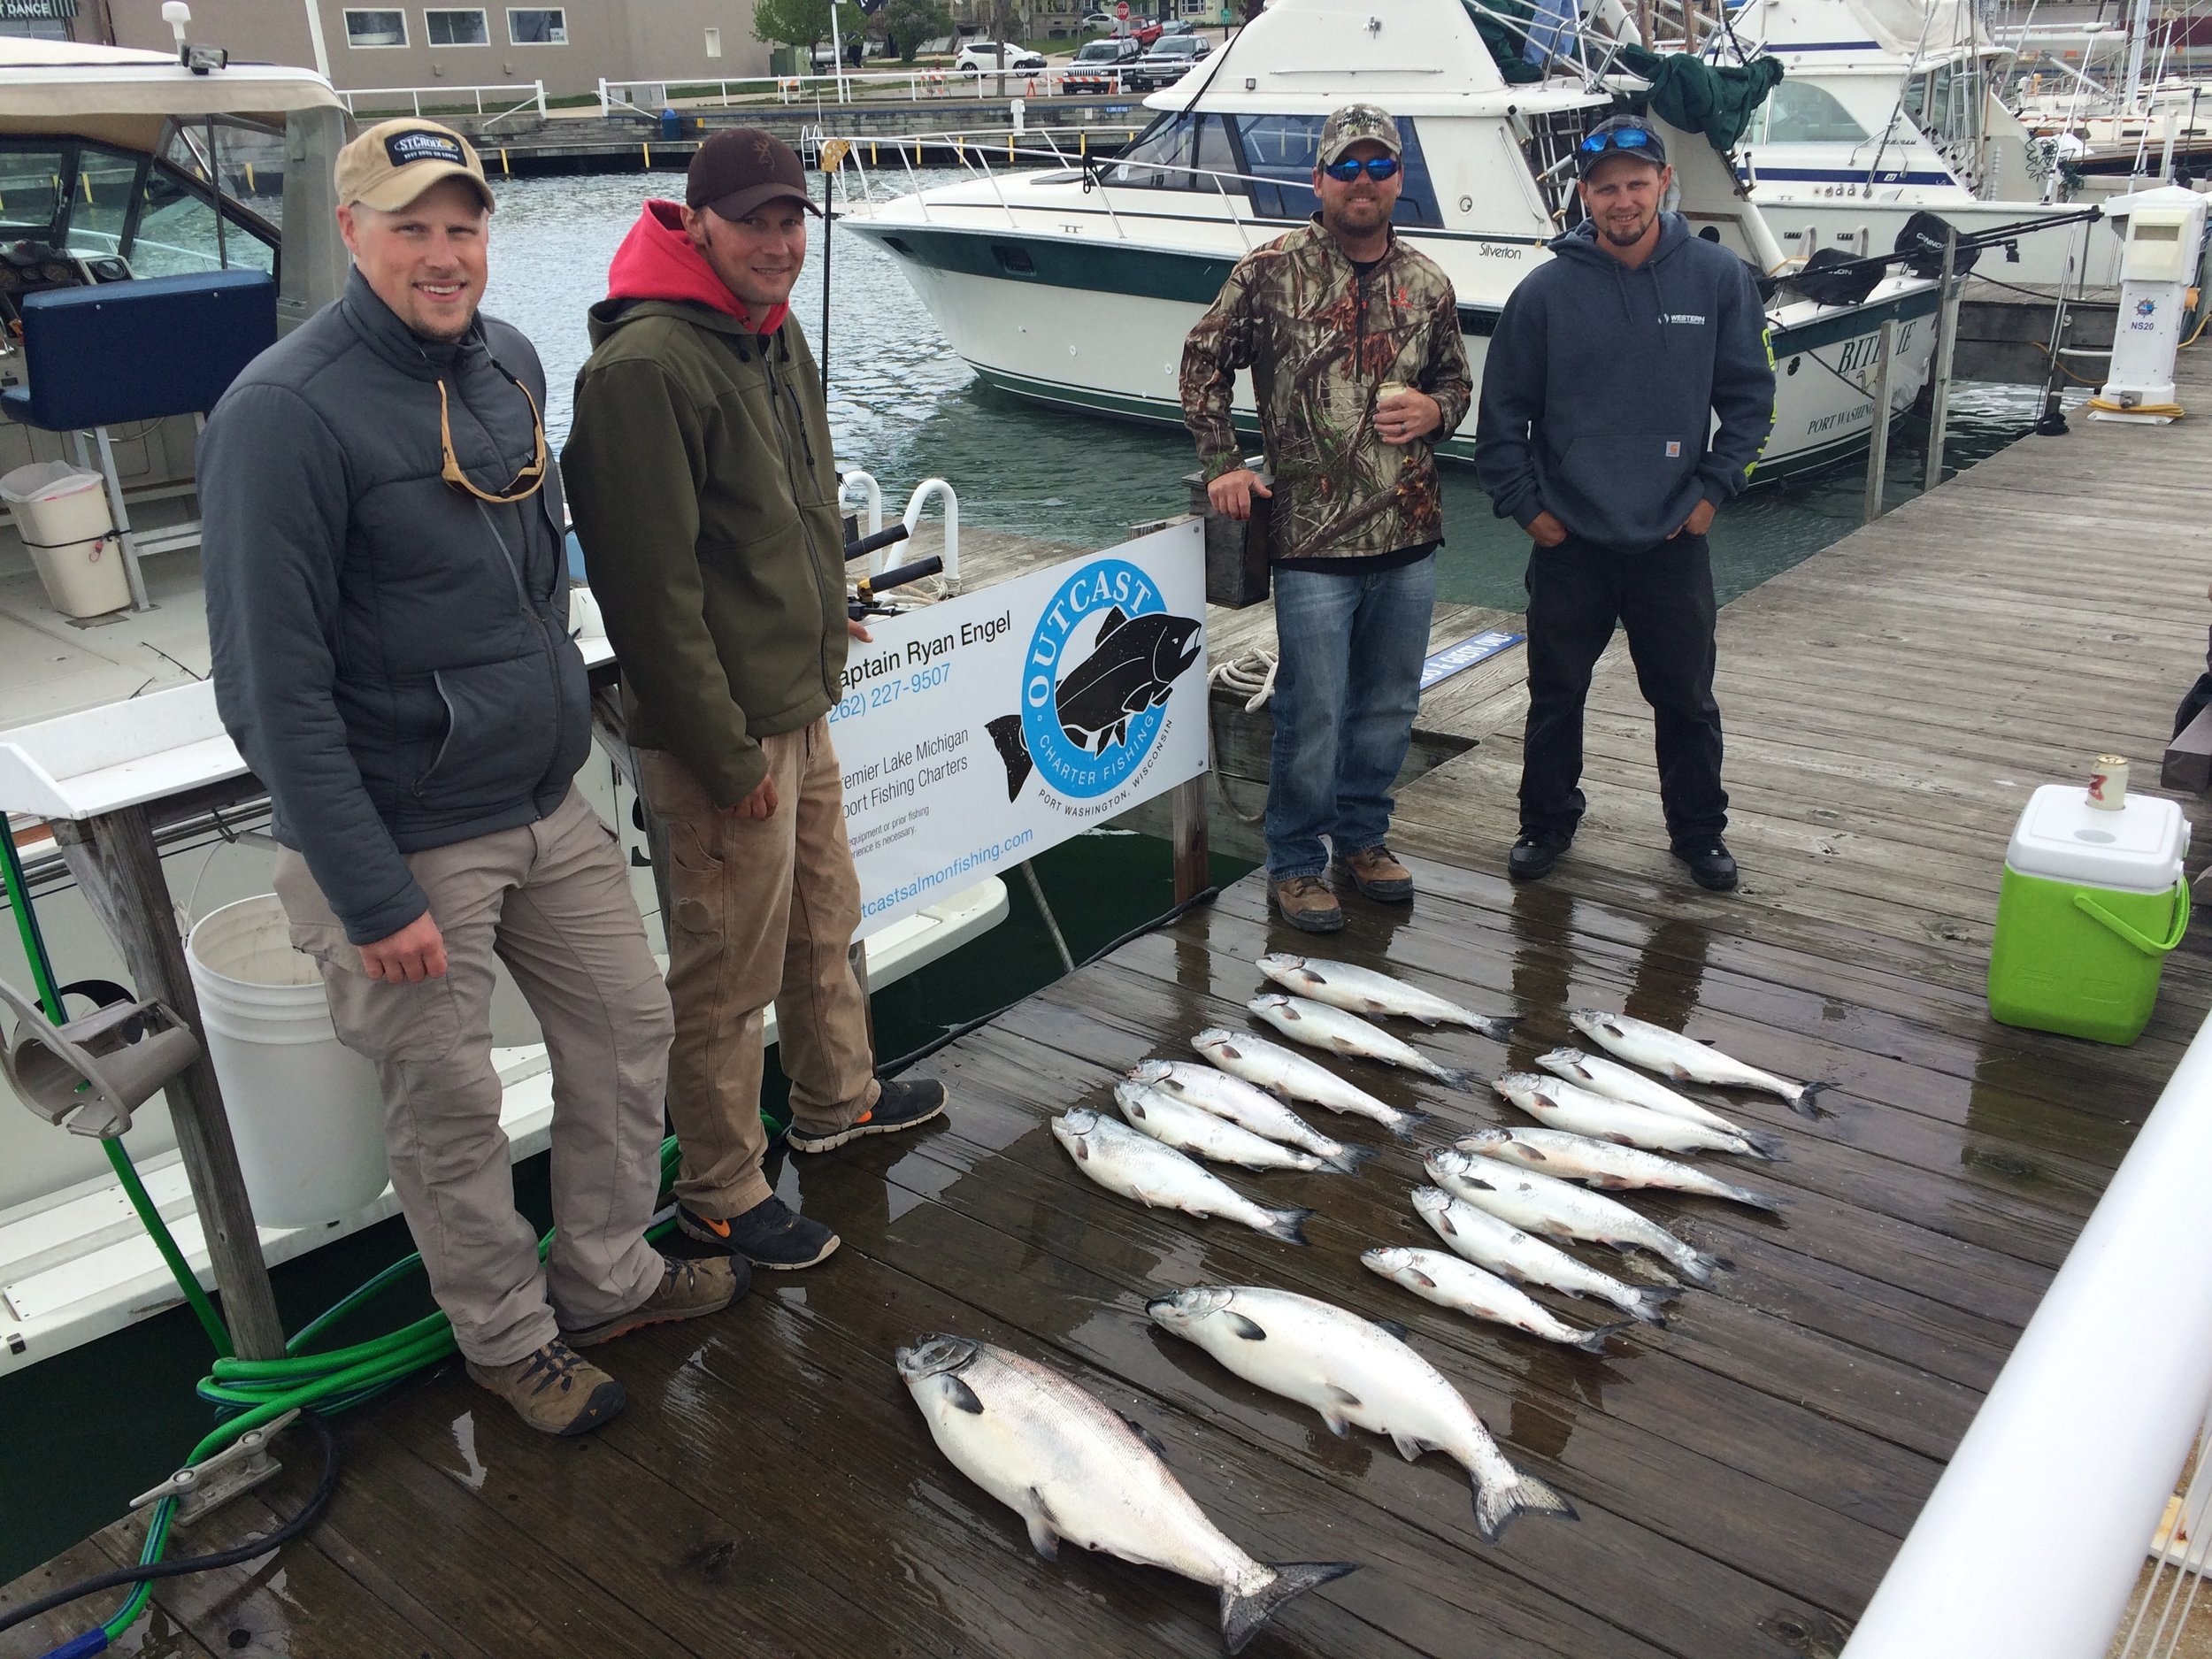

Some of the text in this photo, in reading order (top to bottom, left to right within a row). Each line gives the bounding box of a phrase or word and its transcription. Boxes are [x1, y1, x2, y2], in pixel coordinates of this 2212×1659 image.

[7, 4, 50, 14] DANCE
[1479, 242, 1522, 259] Silverton
[2131, 321, 2154, 331] NS20
[1807, 402, 1876, 434] PORT WASHING
[839, 610, 1011, 689] aptain Ryan Engel
[1027, 570, 1152, 708] OUTCAST
[829, 662, 950, 724] 262) 227-9507
[841, 729, 969, 789] emier Lake Michigan
[1038, 788, 1062, 811] PORT
[1132, 719, 1172, 787] WISCONSIN
[1040, 714, 1155, 785] CHARTER FISHING
[842, 756, 968, 818] port Fishing Charters
[852, 825, 918, 859] rience is necessary.
[883, 822, 891, 832] or
[892, 815, 907, 829] prior
[908, 806, 930, 821] fishing
[861, 828, 1033, 918] tcastsalmonfishing.com
